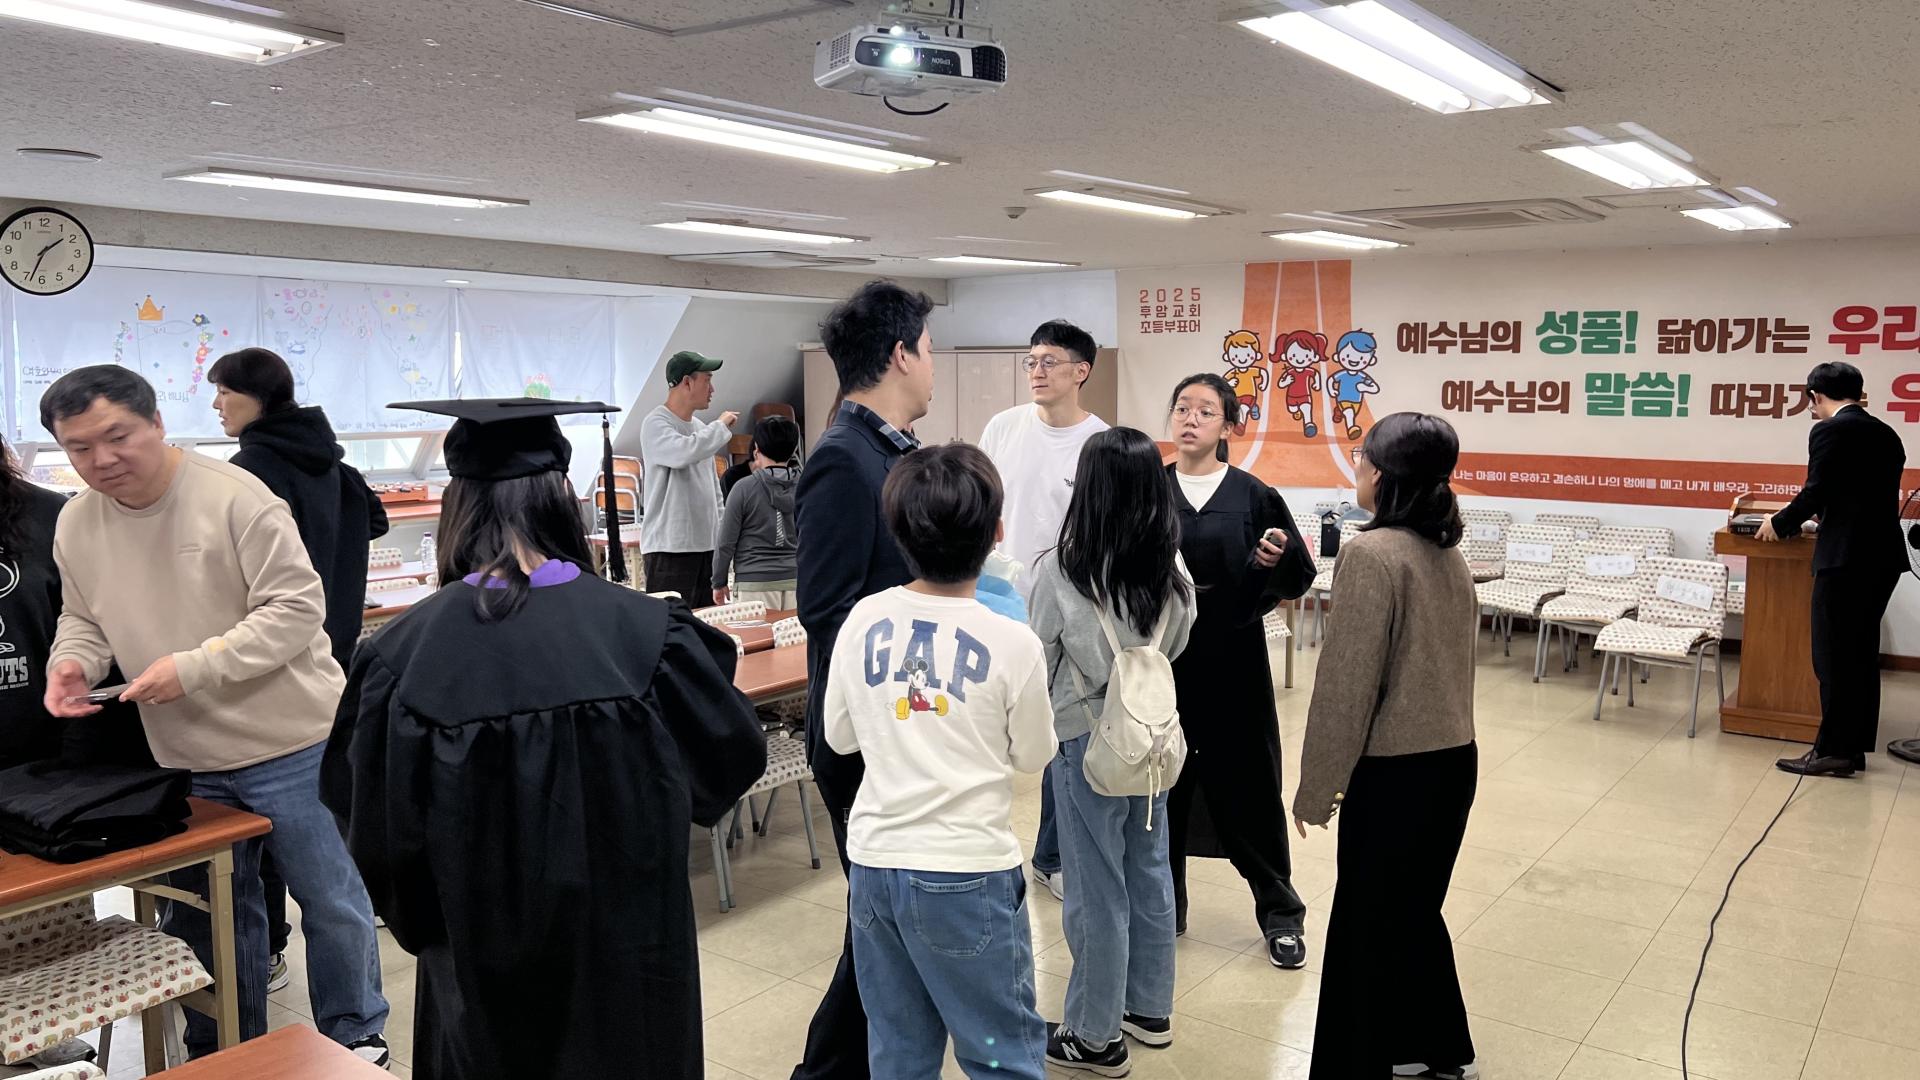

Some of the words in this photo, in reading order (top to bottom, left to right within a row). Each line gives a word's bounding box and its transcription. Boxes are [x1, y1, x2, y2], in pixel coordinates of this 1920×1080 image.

[23, 221, 32, 230] 11
[39, 218, 50, 228] 12
[59, 224, 64, 232] 1
[10, 231, 22, 241] 10
[69, 234, 77, 244] 2
[4, 245, 13, 255] 9
[73, 249, 81, 259] 3
[10, 261, 18, 271] 8
[67, 264, 75, 273] 4
[23, 272, 30, 281] 7
[38, 276, 46, 285] 6
[55, 272, 64, 281] 5
[1139, 319, 1201, 334] 초등부표어
[1397, 320, 1522, 354] 예수님의
[1535, 310, 1639, 355] 성품!
[1657, 317, 1811, 354] 닮아가는
[1441, 380, 1571, 414] 예수님의
[1584, 371, 1692, 418] 말씀!
[1453, 469, 1474, 481] 나는
[1476, 470, 1506, 482] 마음이
[1509, 472, 1550, 484] 온유하고
[1553, 473, 1595, 486] 겸손하니
[1598, 476, 1620, 487] 나의
[1660, 479, 1683, 491] 메고
[1686, 480, 1710, 492] 내게
[1713, 481, 1750, 493] 배우라
[864, 617, 992, 704] GAP
